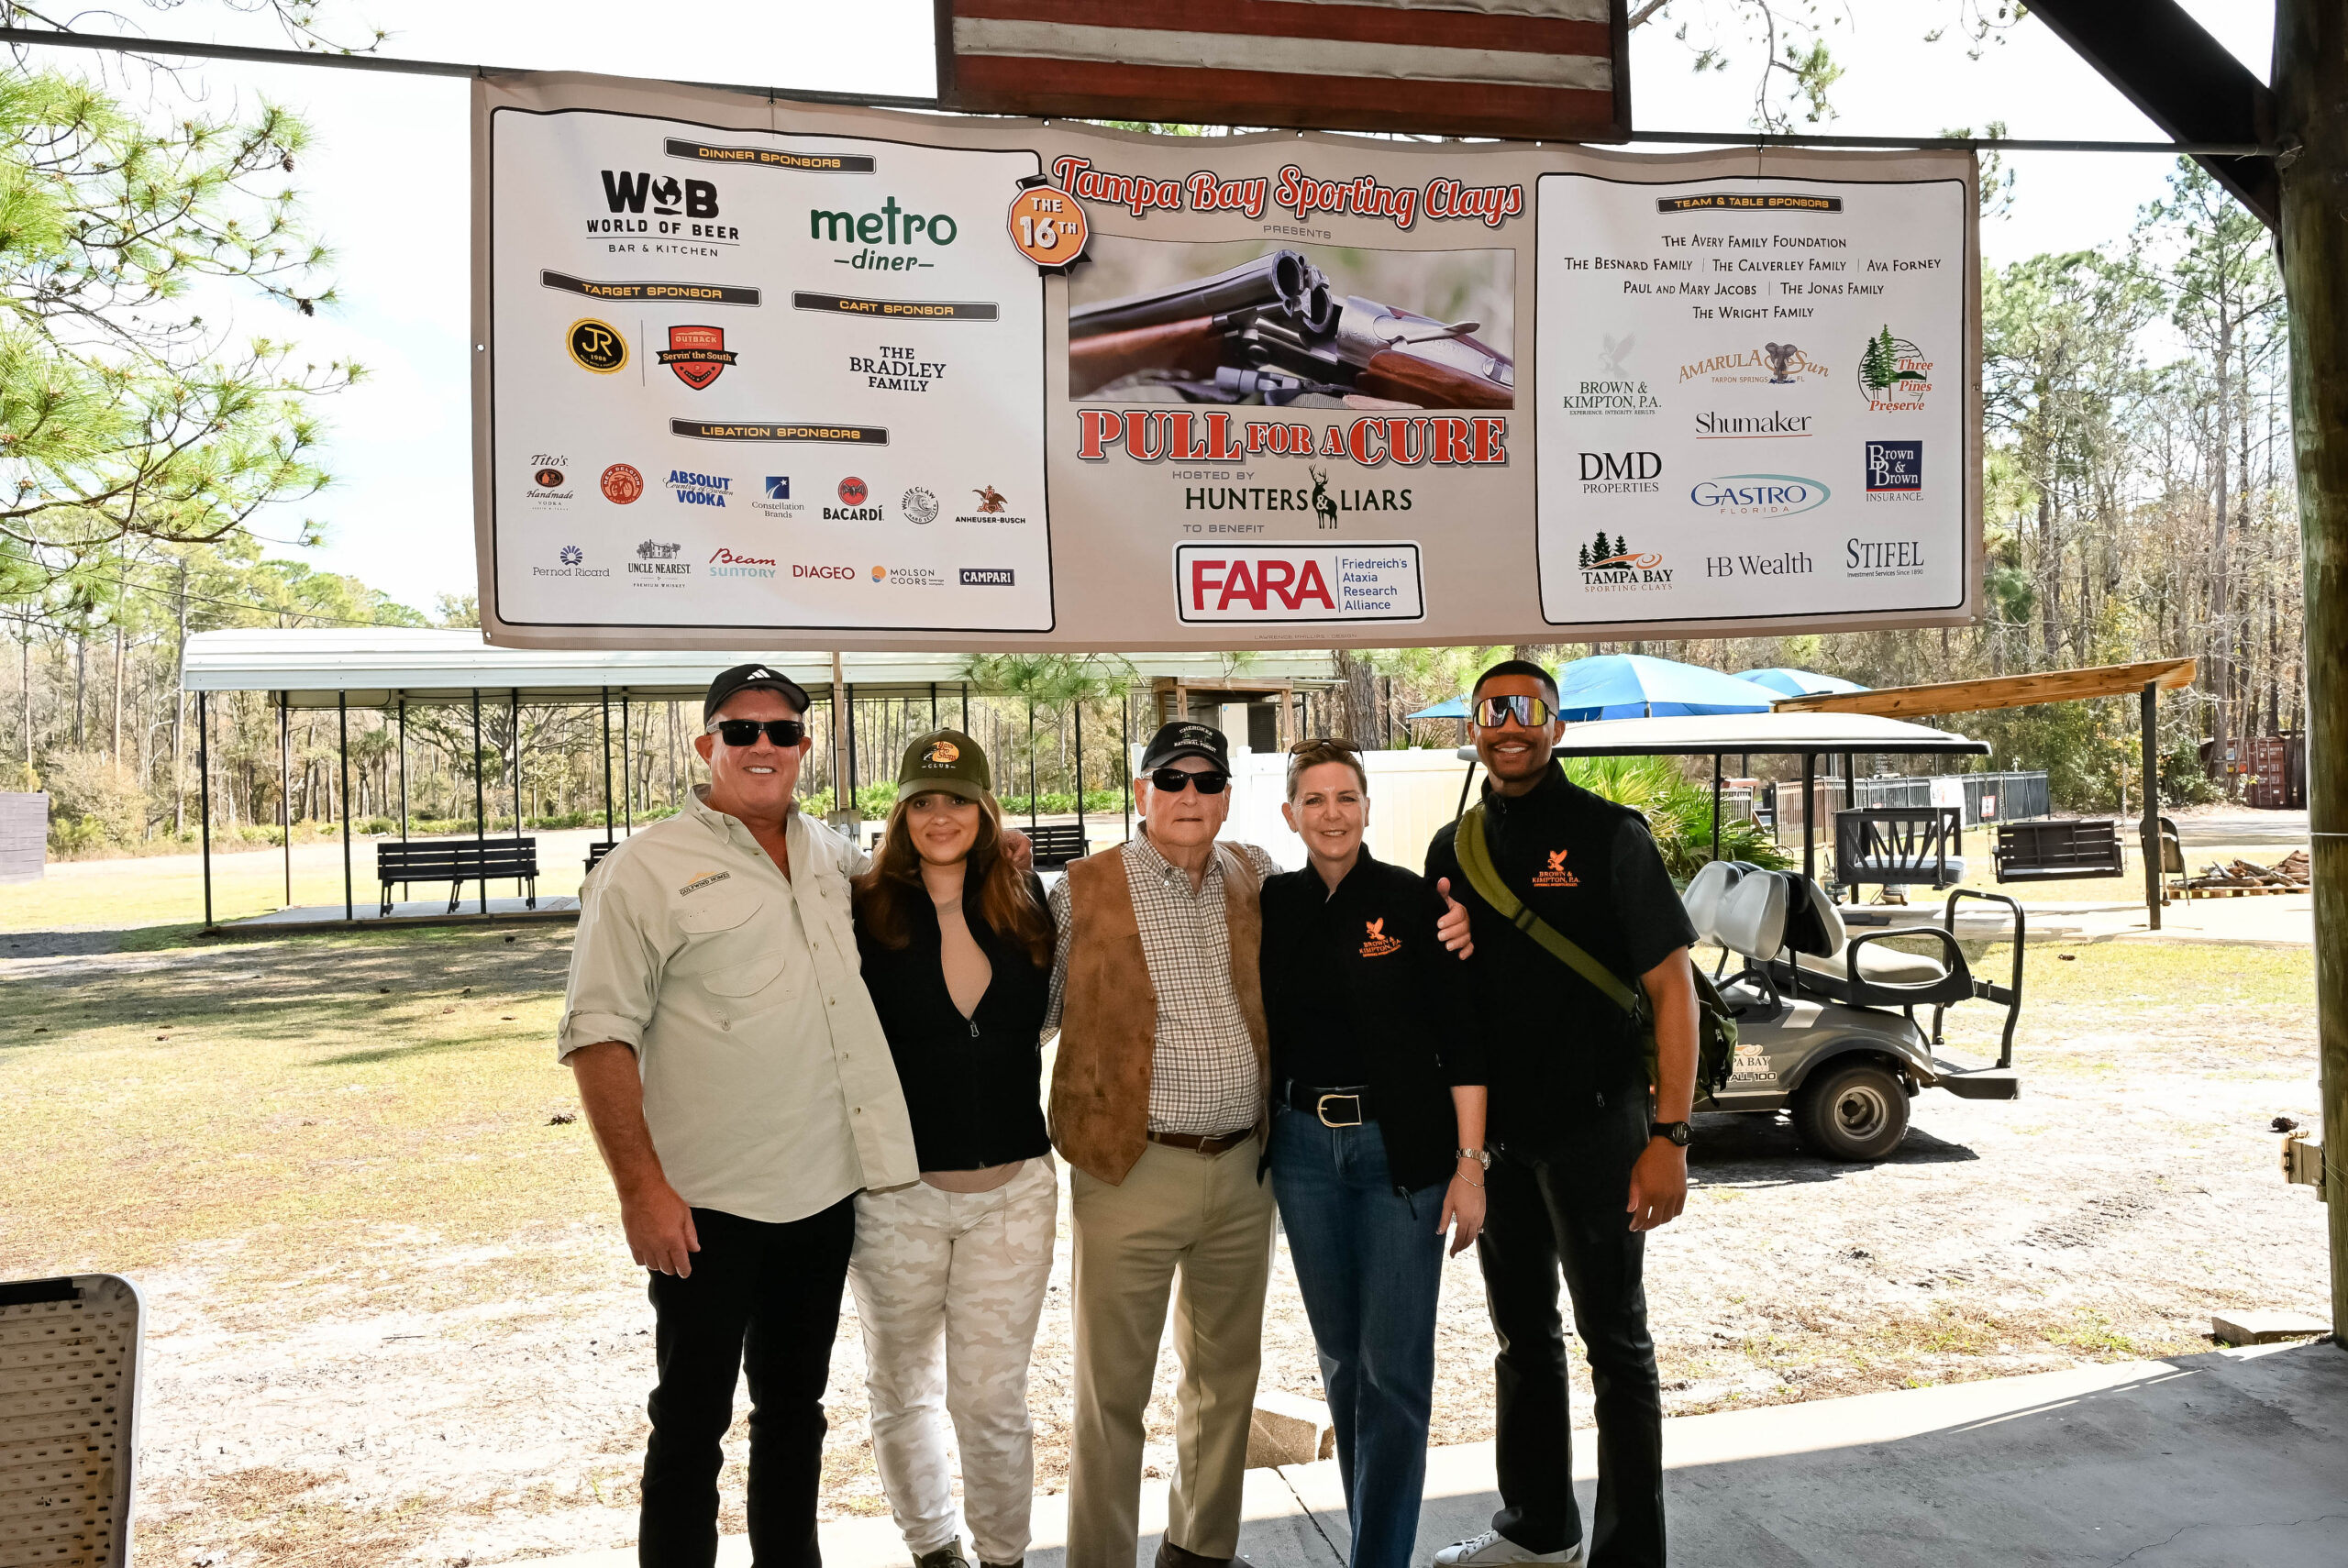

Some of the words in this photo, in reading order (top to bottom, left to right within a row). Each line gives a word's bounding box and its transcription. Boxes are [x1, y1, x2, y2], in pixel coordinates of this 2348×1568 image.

[699, 148, 755, 160] DINNER
[760, 152, 841, 168] SPONSORS
[1053, 155, 1183, 216] Tampa
[1186, 171, 1268, 218] Bay
[1275, 164, 1419, 228] Sporting
[1423, 177, 1523, 227] Clays
[1030, 196, 1063, 214] THE
[1675, 197, 1711, 208] TEAM
[1716, 197, 1725, 205] &
[1729, 197, 1764, 206] TABLE
[1768, 198, 1830, 208] SPONSORS
[810, 195, 958, 246] metro
[586, 219, 648, 233] WORLD
[659, 222, 681, 235] OF
[692, 224, 739, 240] BEER
[1263, 225, 1332, 239] PRESENTS
[1661, 235, 1687, 248] THE
[1691, 234, 1724, 248] AVERY
[1729, 235, 1768, 248] FAMILY
[1773, 235, 1846, 248] FOUNDATION
[608, 244, 636, 253] BAR
[642, 244, 649, 253] &
[656, 245, 719, 257] KITCHEN
[851, 248, 919, 271] diner
[1564, 257, 1589, 271] THE
[1594, 257, 1649, 271] BESNARD
[1653, 259, 1692, 271] FAMILY
[1711, 259, 1733, 271] THE
[1738, 259, 1804, 271] CALVERLEY
[1809, 259, 1846, 271] FAMILY
[1866, 259, 1888, 271] AVA
[1893, 259, 1942, 271] FORNEY
[581, 282, 641, 297] TARGET
[647, 286, 722, 299] SPONSOR
[1623, 281, 1652, 293] PAUL
[1656, 283, 1676, 294] AND
[1679, 282, 1711, 294] MARY
[1714, 282, 1757, 295] JACOBS
[1780, 282, 1803, 294] THE
[1808, 282, 1844, 294] JONAS
[1847, 282, 1884, 294] FAMILY
[839, 300, 878, 314] CART
[883, 304, 954, 315] SPONSOR
[1692, 306, 1713, 319] THE
[1719, 306, 1768, 319] WRIGHT
[1774, 305, 1814, 318] FAMILY
[581, 326, 613, 357] JR
[675, 336, 717, 344] OUTBACK
[662, 351, 692, 361] Servin'
[692, 350, 706, 360] the
[706, 351, 732, 362] South
[880, 346, 915, 359] THE
[849, 357, 947, 380] BRADLEY
[1678, 349, 1763, 384] AMARULA
[1764, 349, 1829, 378] Sun
[1898, 359, 1933, 370] Three
[868, 376, 929, 392] FAMILY
[1579, 381, 1634, 394] BROWN
[1637, 381, 1648, 394] &
[1899, 380, 1933, 392] Pines
[1563, 395, 1636, 409] KIMPTON,
[1639, 395, 1662, 408] P.A.
[1868, 400, 1924, 412] Preserve
[1696, 410, 1812, 434] Shumaker
[701, 425, 770, 437] LIBATION
[776, 427, 861, 440] SPONSORS
[1077, 409, 1243, 461] PULL
[1246, 422, 1314, 456] FOR
[1320, 425, 1347, 457] A
[1347, 415, 1507, 466] CURE
[530, 453, 568, 467] Tito's
[1867, 445, 1914, 470] Brown
[1578, 451, 1662, 480] DMD
[1895, 461, 1906, 473] &
[604, 469, 613, 485] NEW
[615, 466, 640, 486] BELGIUM
[669, 469, 730, 491] ABSOLUT
[1172, 470, 1230, 480] HOSTED
[1236, 471, 1255, 480] BY
[1874, 461, 1919, 486] Brown
[662, 477, 695, 492] Country
[1583, 482, 1659, 494] PROPERTIES
[526, 489, 573, 500] Handmade
[676, 489, 726, 508] VODKA
[902, 488, 914, 511] WHITE
[914, 486, 936, 500] CLAW
[1186, 488, 1308, 512] HUNTERS
[1315, 494, 1329, 510] &
[1340, 489, 1412, 512] LIARS
[1690, 481, 1807, 507] GASTRO
[1866, 491, 1922, 502] INSURANCE
[751, 502, 804, 511] Constellation
[824, 505, 882, 522] BACARDÍ
[1721, 506, 1789, 514] FLORIDA
[764, 510, 792, 518] Brands
[908, 513, 922, 522] HARD
[1183, 525, 1202, 533] TO
[1209, 525, 1265, 534] BENEFIT
[709, 548, 777, 566] Beam
[1846, 537, 1925, 569] STIFEL
[627, 562, 654, 574] UNCLE
[655, 563, 691, 574] NEAREST
[1342, 558, 1408, 569] Friedreich's
[1706, 556, 1733, 578] HB
[1738, 551, 1813, 576] Wealth
[532, 567, 571, 577] Pernod
[574, 567, 610, 578] Ricard
[792, 564, 856, 580] DIAGEO
[890, 569, 935, 577] MOLSON
[963, 571, 1012, 583] CAMPARI
[1343, 572, 1379, 583] Ataxia
[1581, 570, 1640, 585] TAMPA
[1643, 569, 1674, 583] BAY
[891, 578, 927, 586] COORS
[1192, 560, 1336, 611] FARA
[1585, 584, 1637, 593] SPORTING
[1641, 583, 1673, 591] CLAYS
[1344, 585, 1398, 597] Research
[1345, 600, 1391, 611] Alliance
[679, 879, 710, 896] GULFWIND
[710, 872, 730, 884] HOMES
[1363, 939, 1389, 948] BROWN
[1747, 1056, 1769, 1066] BAY
